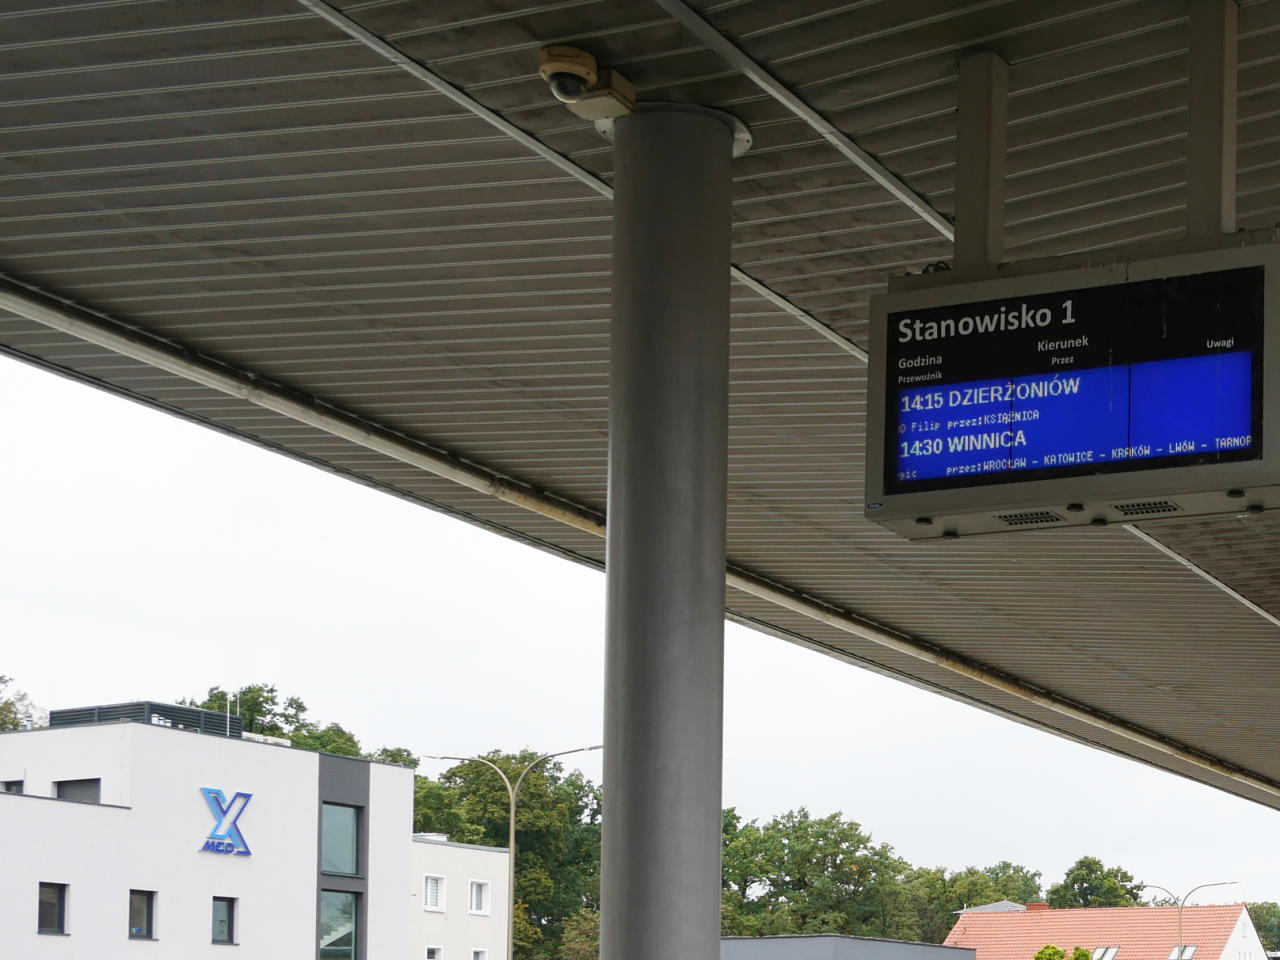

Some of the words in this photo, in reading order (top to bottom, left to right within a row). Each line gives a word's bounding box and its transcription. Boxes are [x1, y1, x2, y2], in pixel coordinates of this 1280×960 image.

[898, 303, 1052, 343] Stanowisko
[1061, 300, 1076, 324] 1
[1037, 335, 1089, 352] Kierunek
[1206, 337, 1234, 349] Uwagi
[898, 355, 943, 369] Godzina
[1051, 355, 1074, 365] Przez
[898, 371, 943, 384] Przewoźnik
[901, 392, 944, 412] 14:15
[949, 374, 1081, 407] DZIERŻONIÓW
[911, 421, 941, 432] Filip
[900, 438, 943, 457] 14:30
[947, 430, 1027, 452] WINNICA
[1044, 451, 1093, 465] KATOWICE
[1111, 444, 1150, 459] KRAKÓW
[1169, 440, 1195, 453] LWÓW
[199, 840, 235, 854] MED
